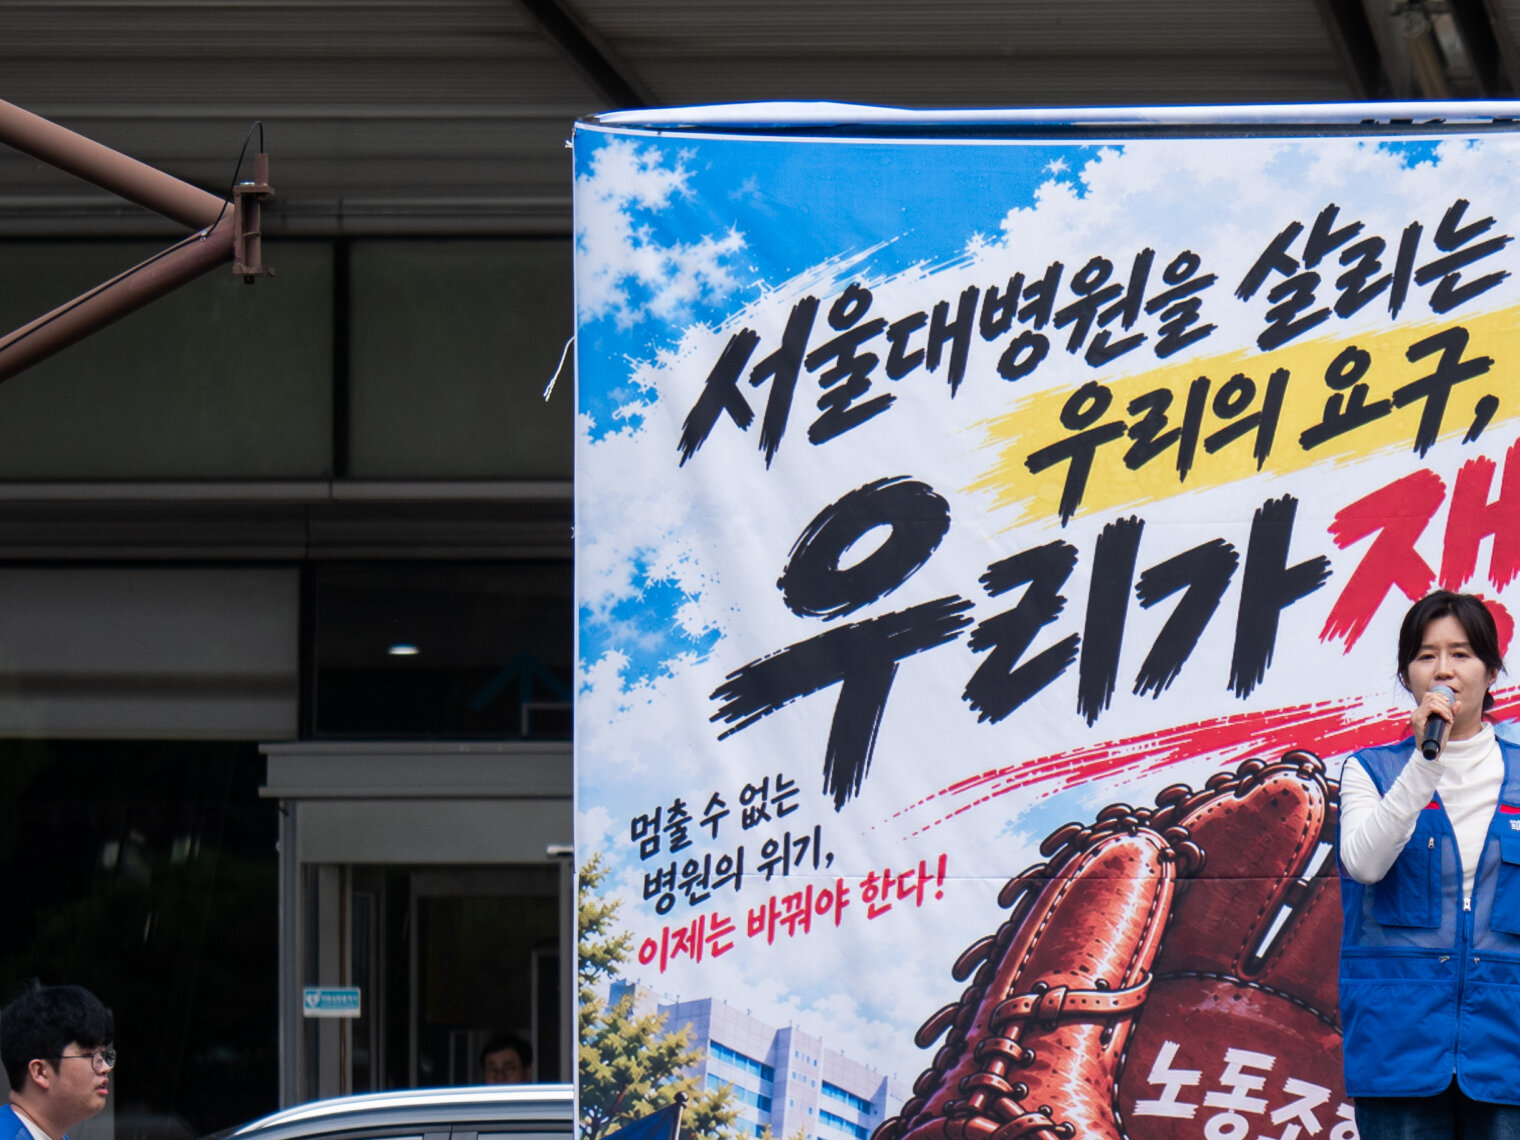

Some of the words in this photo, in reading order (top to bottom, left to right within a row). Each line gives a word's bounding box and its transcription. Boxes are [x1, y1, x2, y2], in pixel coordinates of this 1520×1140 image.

[678, 248, 1218, 470] 서울대병원을
[1236, 199, 1514, 351] 살리는
[1024, 367, 1289, 527] 우리의
[1299, 326, 1499, 458] 요구,
[709, 475, 1334, 812] 우리가
[631, 798, 693, 861] 멈출
[700, 792, 730, 839] 수
[739, 772, 800, 830] 없는
[643, 846, 744, 915] 병원의
[757, 825, 834, 881] 위기,
[638, 912, 736, 974] 이제는
[748, 877, 850, 945] 바꿔야
[859, 853, 947, 920] 한다!
